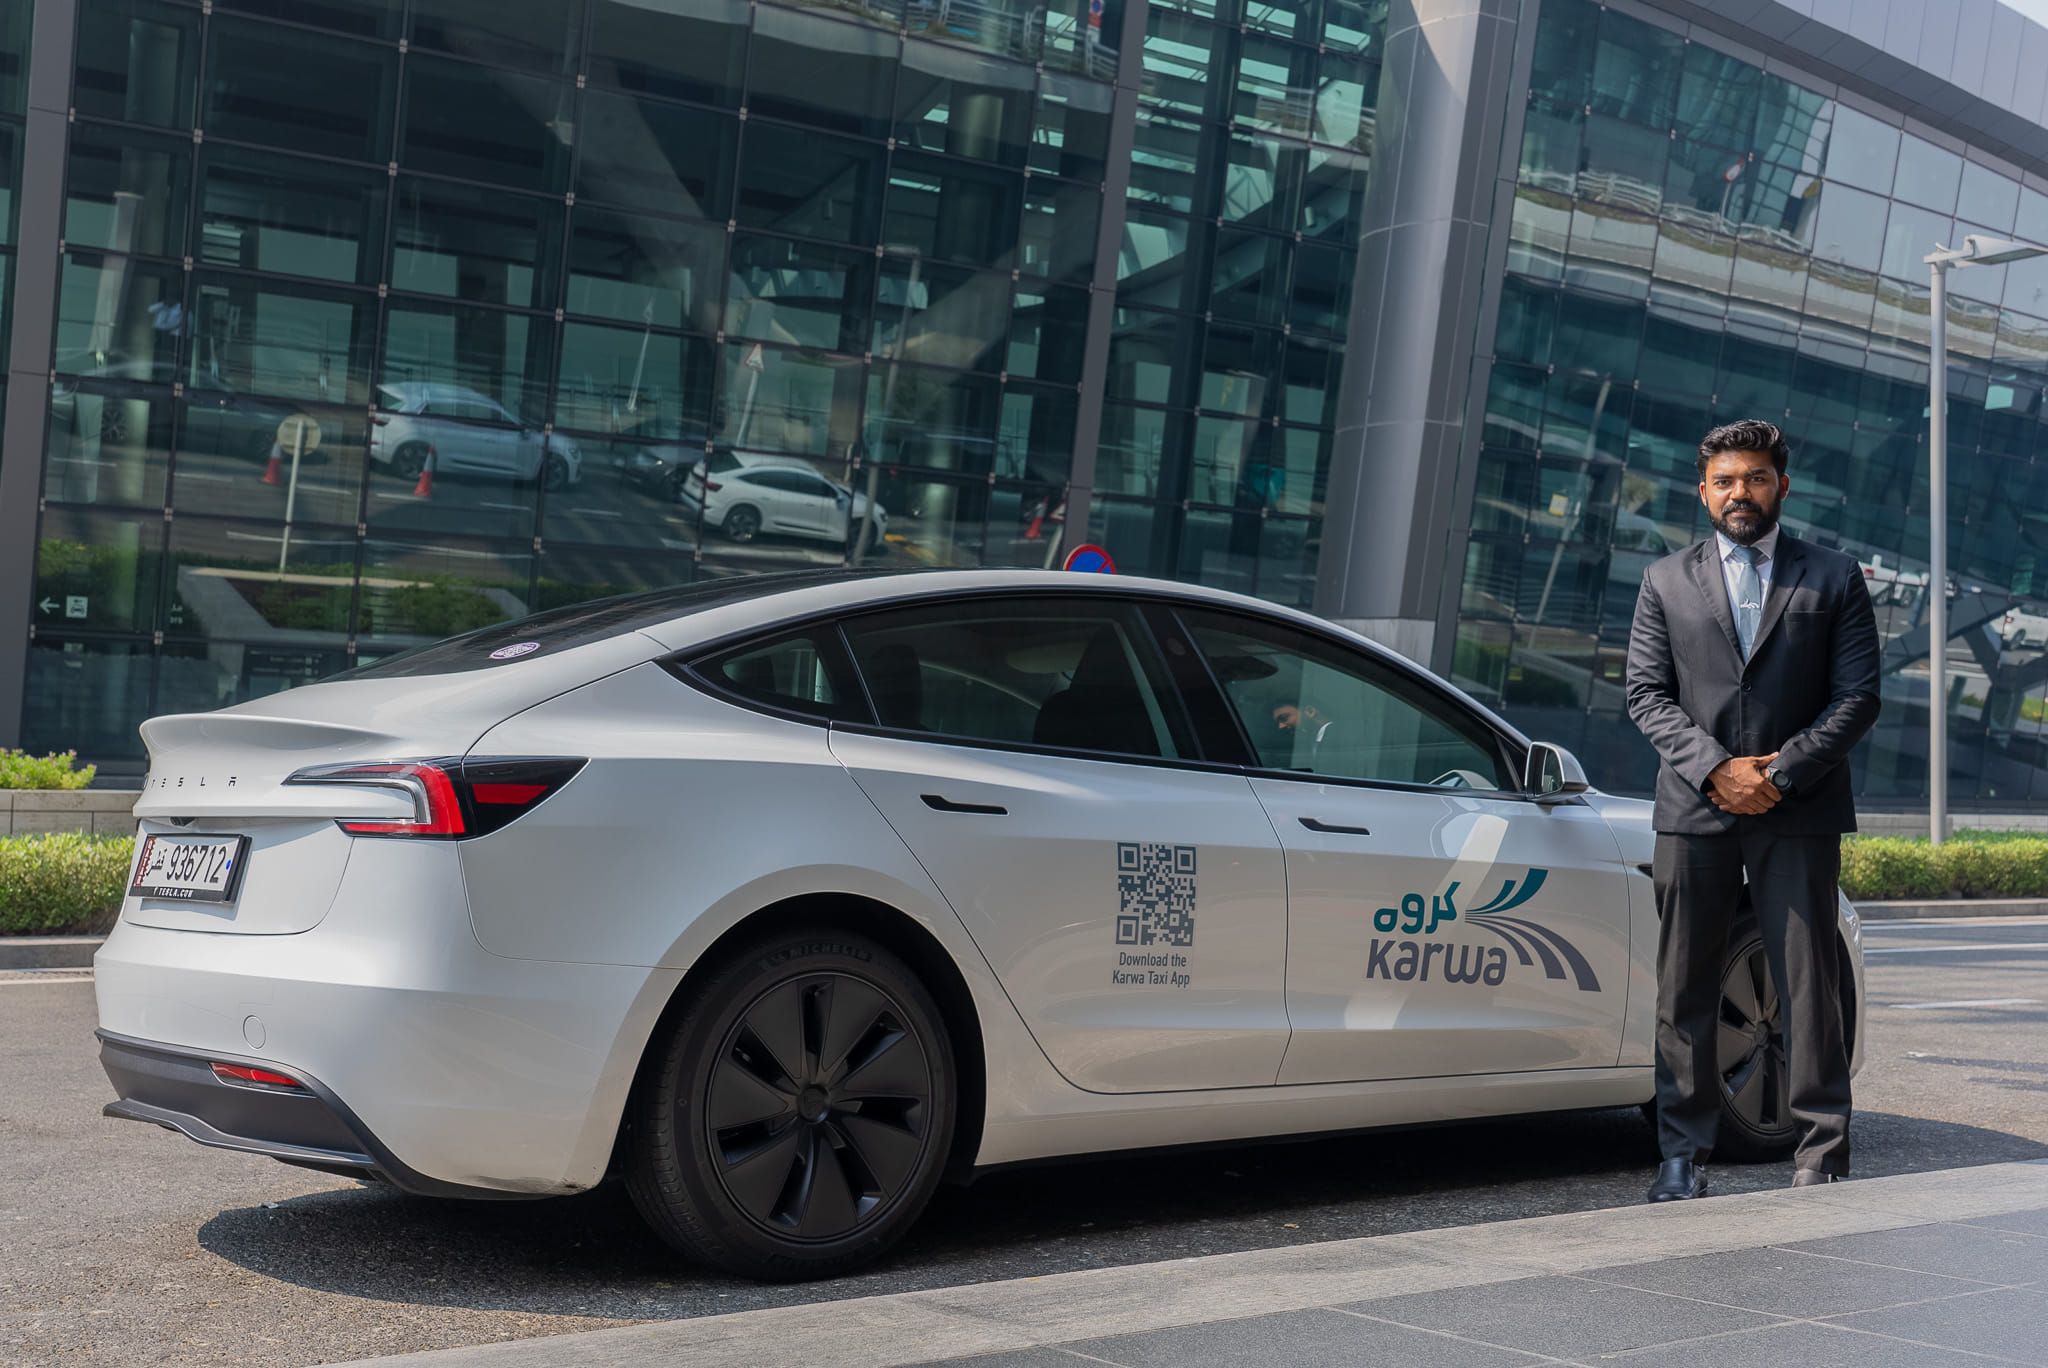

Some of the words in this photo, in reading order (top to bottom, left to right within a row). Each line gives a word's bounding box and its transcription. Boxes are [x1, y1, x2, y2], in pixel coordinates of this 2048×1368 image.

[152, 776, 237, 787] TESLA
[166, 845, 227, 884] 936712
[1119, 951, 1168, 967] Download
[1171, 953, 1187, 967] the
[1112, 969, 1145, 985] Karwa
[1147, 970, 1169, 985] Taxi
[1170, 971, 1190, 988] App
